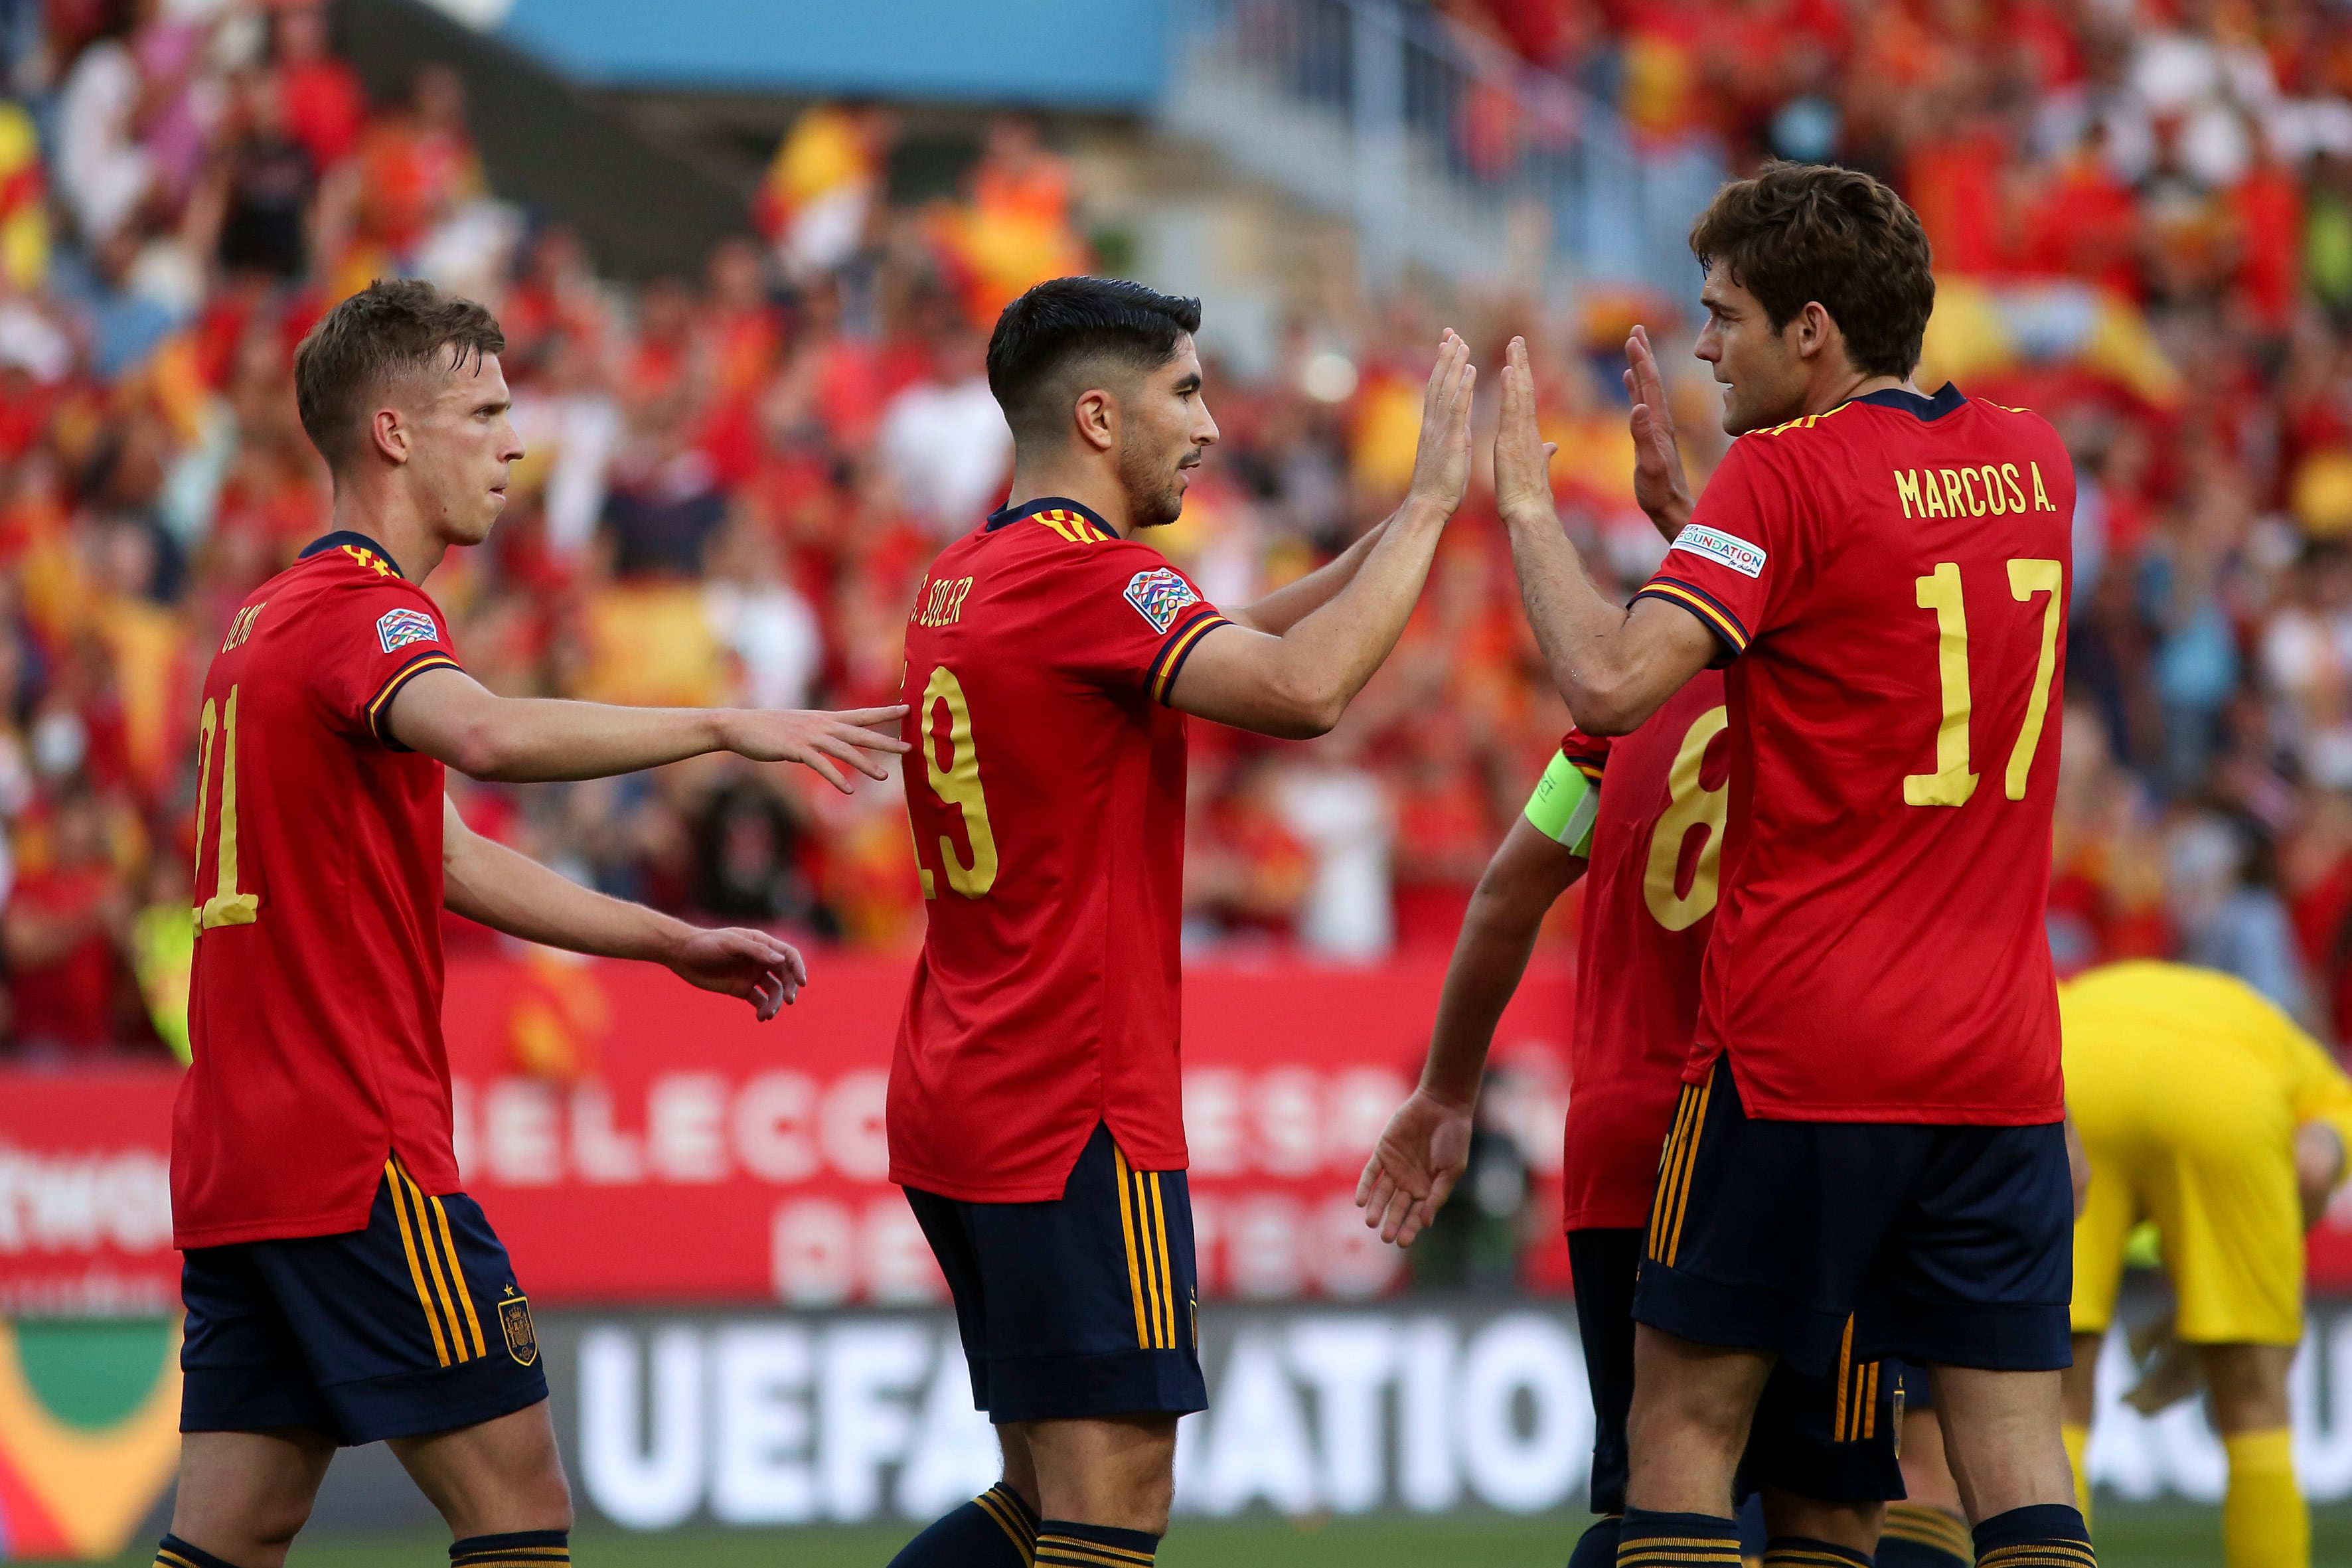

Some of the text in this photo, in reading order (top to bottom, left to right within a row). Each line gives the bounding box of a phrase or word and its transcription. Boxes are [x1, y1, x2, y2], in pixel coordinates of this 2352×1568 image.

[1893, 461, 2057, 518] MARCOS A.
[919, 576, 974, 628] SOLER
[1903, 558, 2063, 807] 17
[1643, 704, 1729, 932] 8
